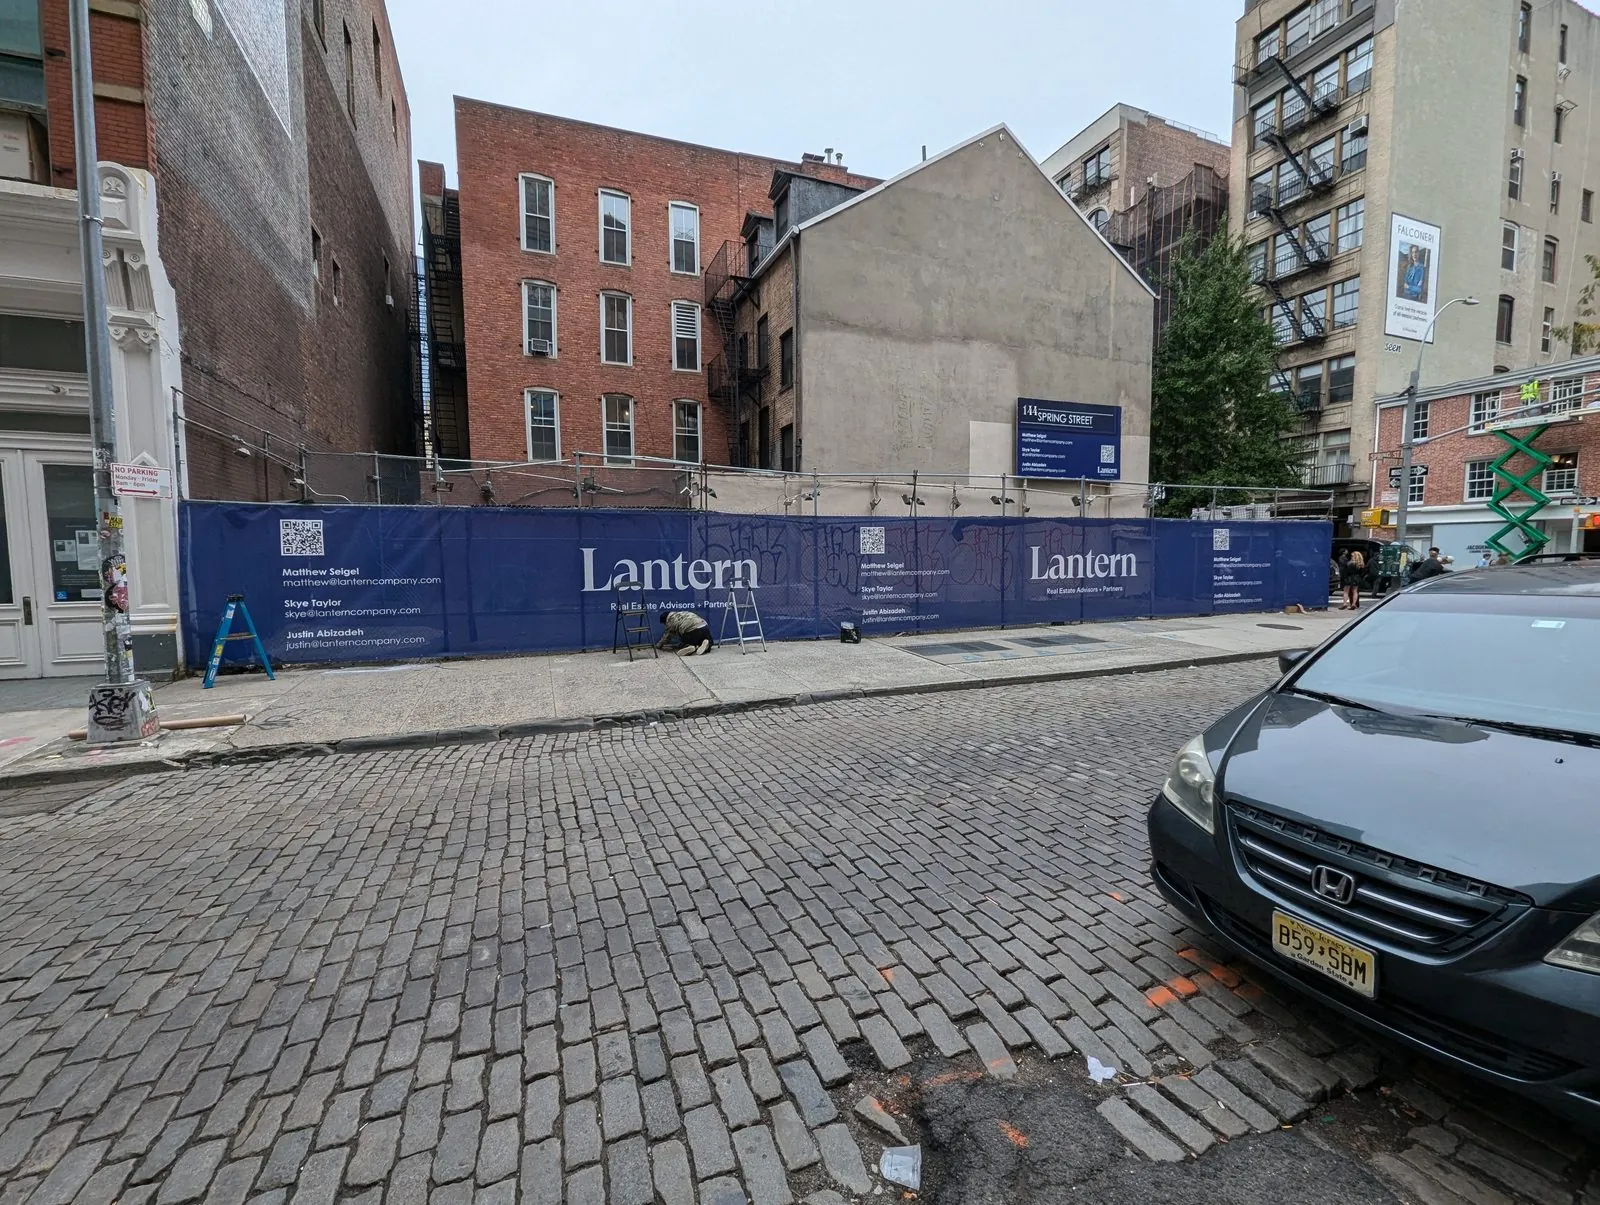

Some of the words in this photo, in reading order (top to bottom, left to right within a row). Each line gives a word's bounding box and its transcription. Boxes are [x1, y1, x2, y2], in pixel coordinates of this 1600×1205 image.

[1397, 224, 1435, 242] FALCONERI
[1384, 342, 1402, 352] seen
[1022, 404, 1038, 416] 144
[1038, 412, 1067, 424] SPRING
[1068, 414, 1093, 425] STREET
[128, 468, 158, 476] PARKING
[579, 548, 761, 592] Lantern
[1030, 546, 1138, 580] Lantern
[282, 568, 327, 576] Matthew
[330, 567, 360, 577] Seigel
[283, 576, 441, 587] matthew@lanterncompany.com
[284, 599, 309, 609] Skye
[312, 599, 341, 608] Taylor
[285, 607, 420, 620] skye@lanterncompany.com
[287, 631, 314, 639] Justin
[317, 629, 364, 638] Abizadeh
[286, 636, 425, 651] justin@lanterncompany.com
[1296, 922, 1317, 937] New
[1319, 932, 1347, 951] Jersey
[1280, 924, 1314, 956] B59
[1328, 946, 1366, 984] SBM
[1296, 953, 1324, 970] Garden
[1326, 967, 1347, 982] State
